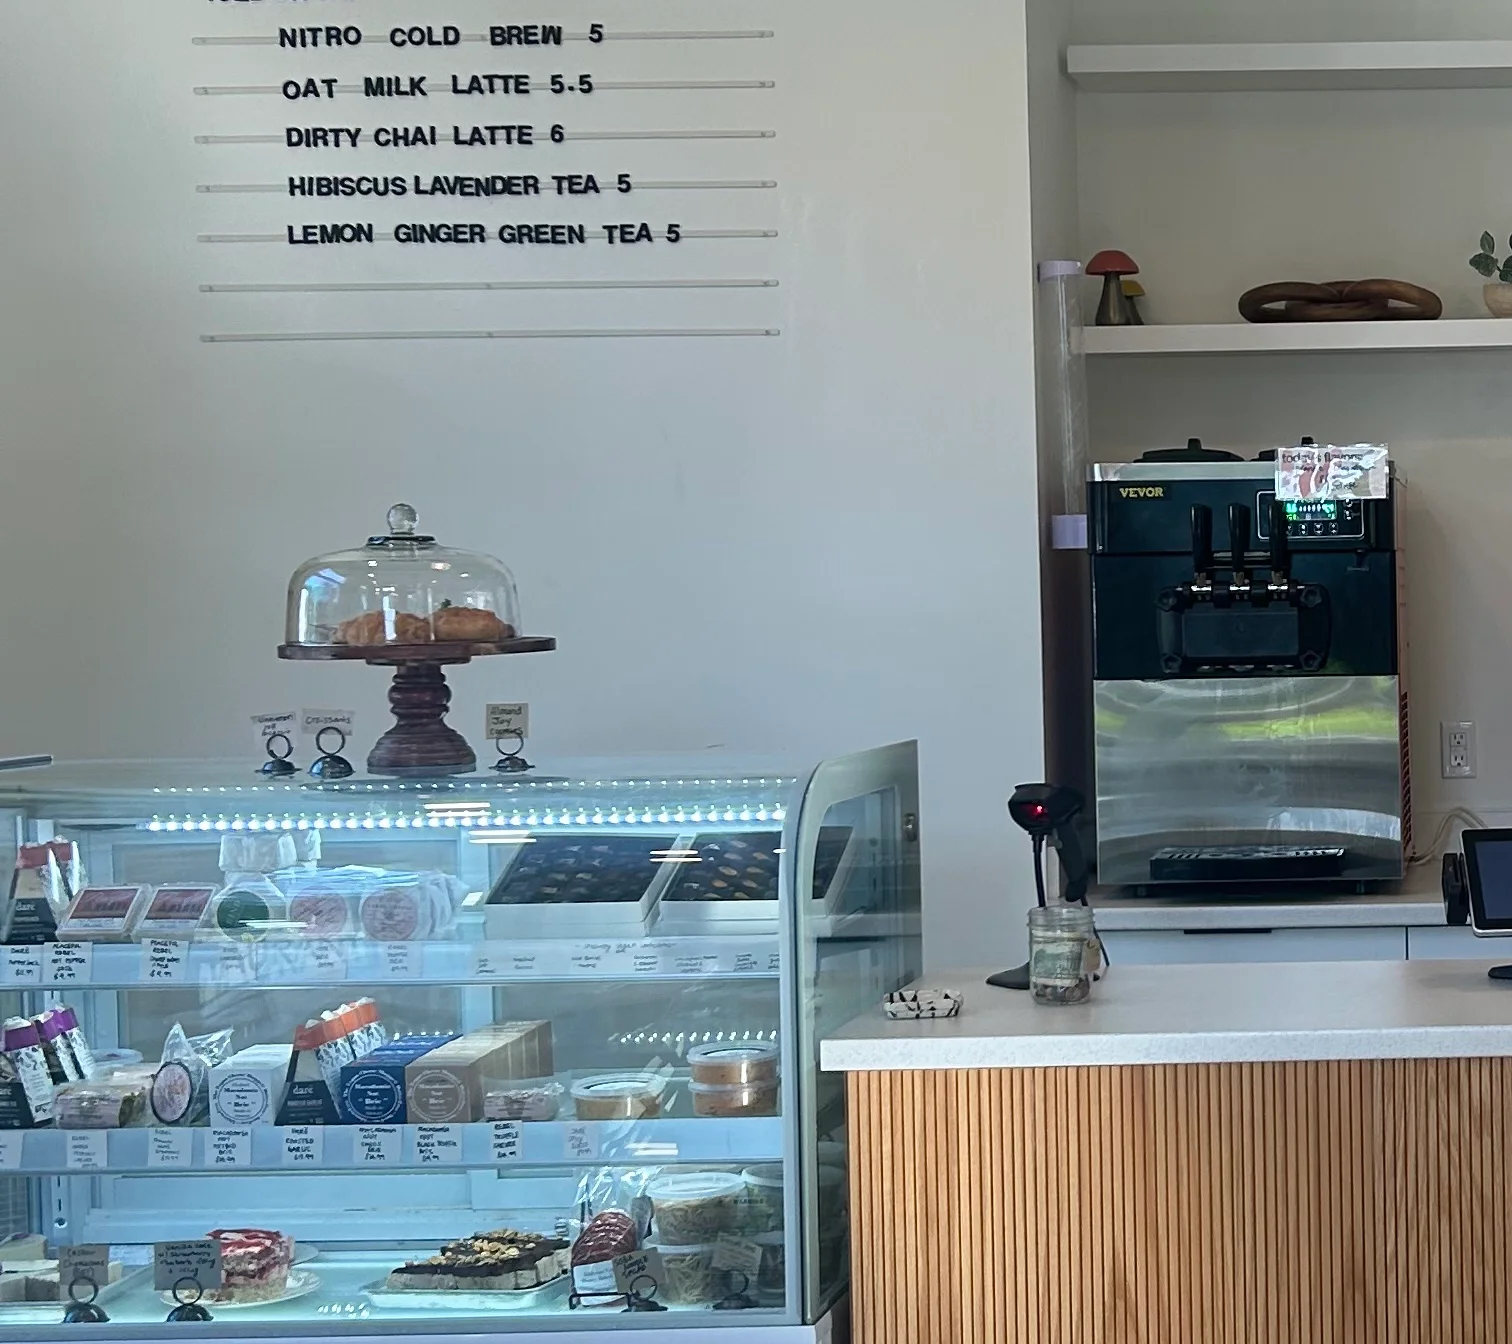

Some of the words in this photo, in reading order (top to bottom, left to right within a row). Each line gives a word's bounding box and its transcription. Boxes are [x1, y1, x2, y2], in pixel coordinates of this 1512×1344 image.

[280, 26, 361, 47] NITRO
[390, 26, 460, 47] COLD
[490, 25, 561, 46] BREW
[589, 24, 603, 43] 5
[283, 79, 337, 99] OAT
[365, 76, 427, 96] MILK
[452, 75, 529, 94] LATTE
[551, 74, 592, 93] 5.5
[287, 128, 361, 147] DIRTY
[374, 126, 436, 146] CHAI
[454, 126, 532, 146] LATTE
[551, 124, 564, 143] 6
[289, 177, 407, 196] HIBISCUS
[415, 176, 539, 197] LAVENDER
[552, 175, 600, 195] TEA
[618, 174, 631, 193] 5
[288, 224, 373, 244] LEMON
[394, 224, 485, 243] GINGER
[499, 224, 584, 244] GREEN
[603, 223, 652, 244] TEA
[666, 224, 680, 242] 5
[1119, 487, 1164, 498] VEVOR
